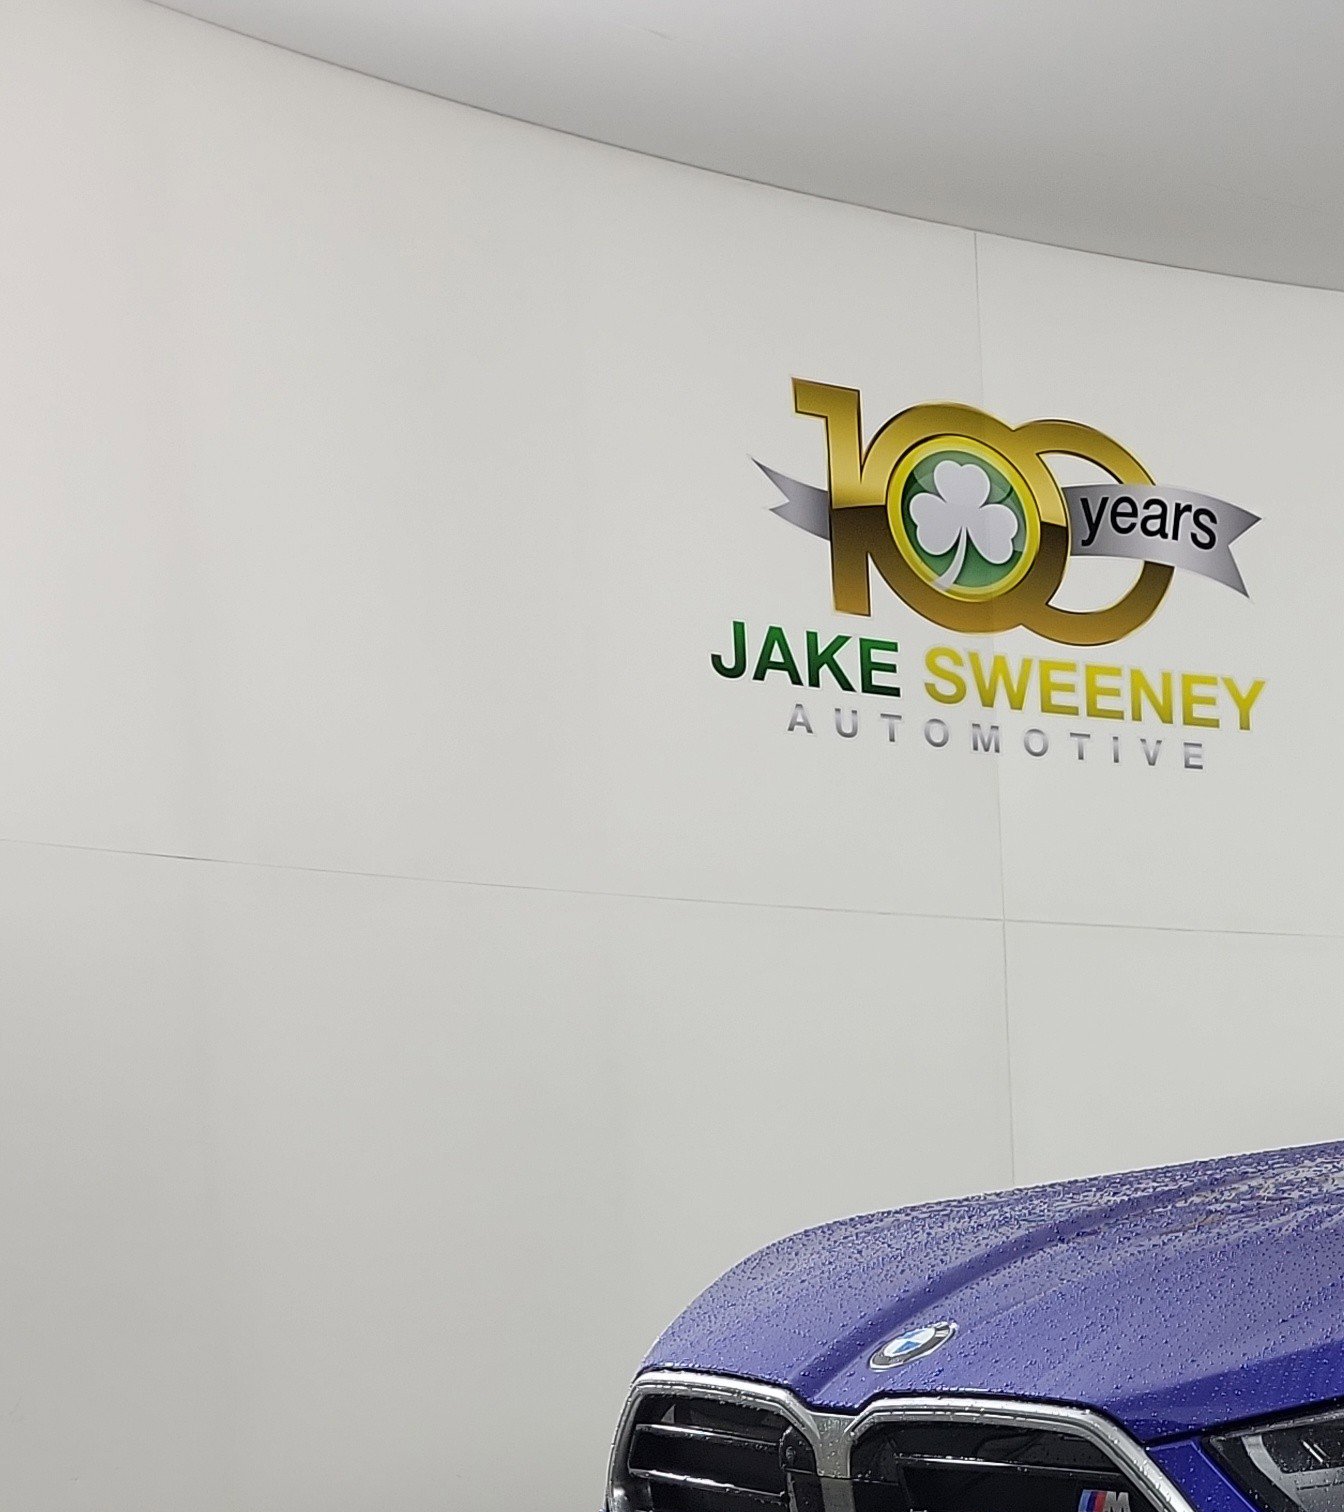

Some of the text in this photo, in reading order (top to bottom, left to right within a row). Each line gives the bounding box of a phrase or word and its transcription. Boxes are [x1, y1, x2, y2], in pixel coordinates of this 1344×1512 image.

[791, 377, 1174, 646] 100
[1080, 494, 1218, 550] years
[710, 620, 1266, 731] JAKE SWEENEY
[786, 703, 1205, 770] AUTOMOTIVE
